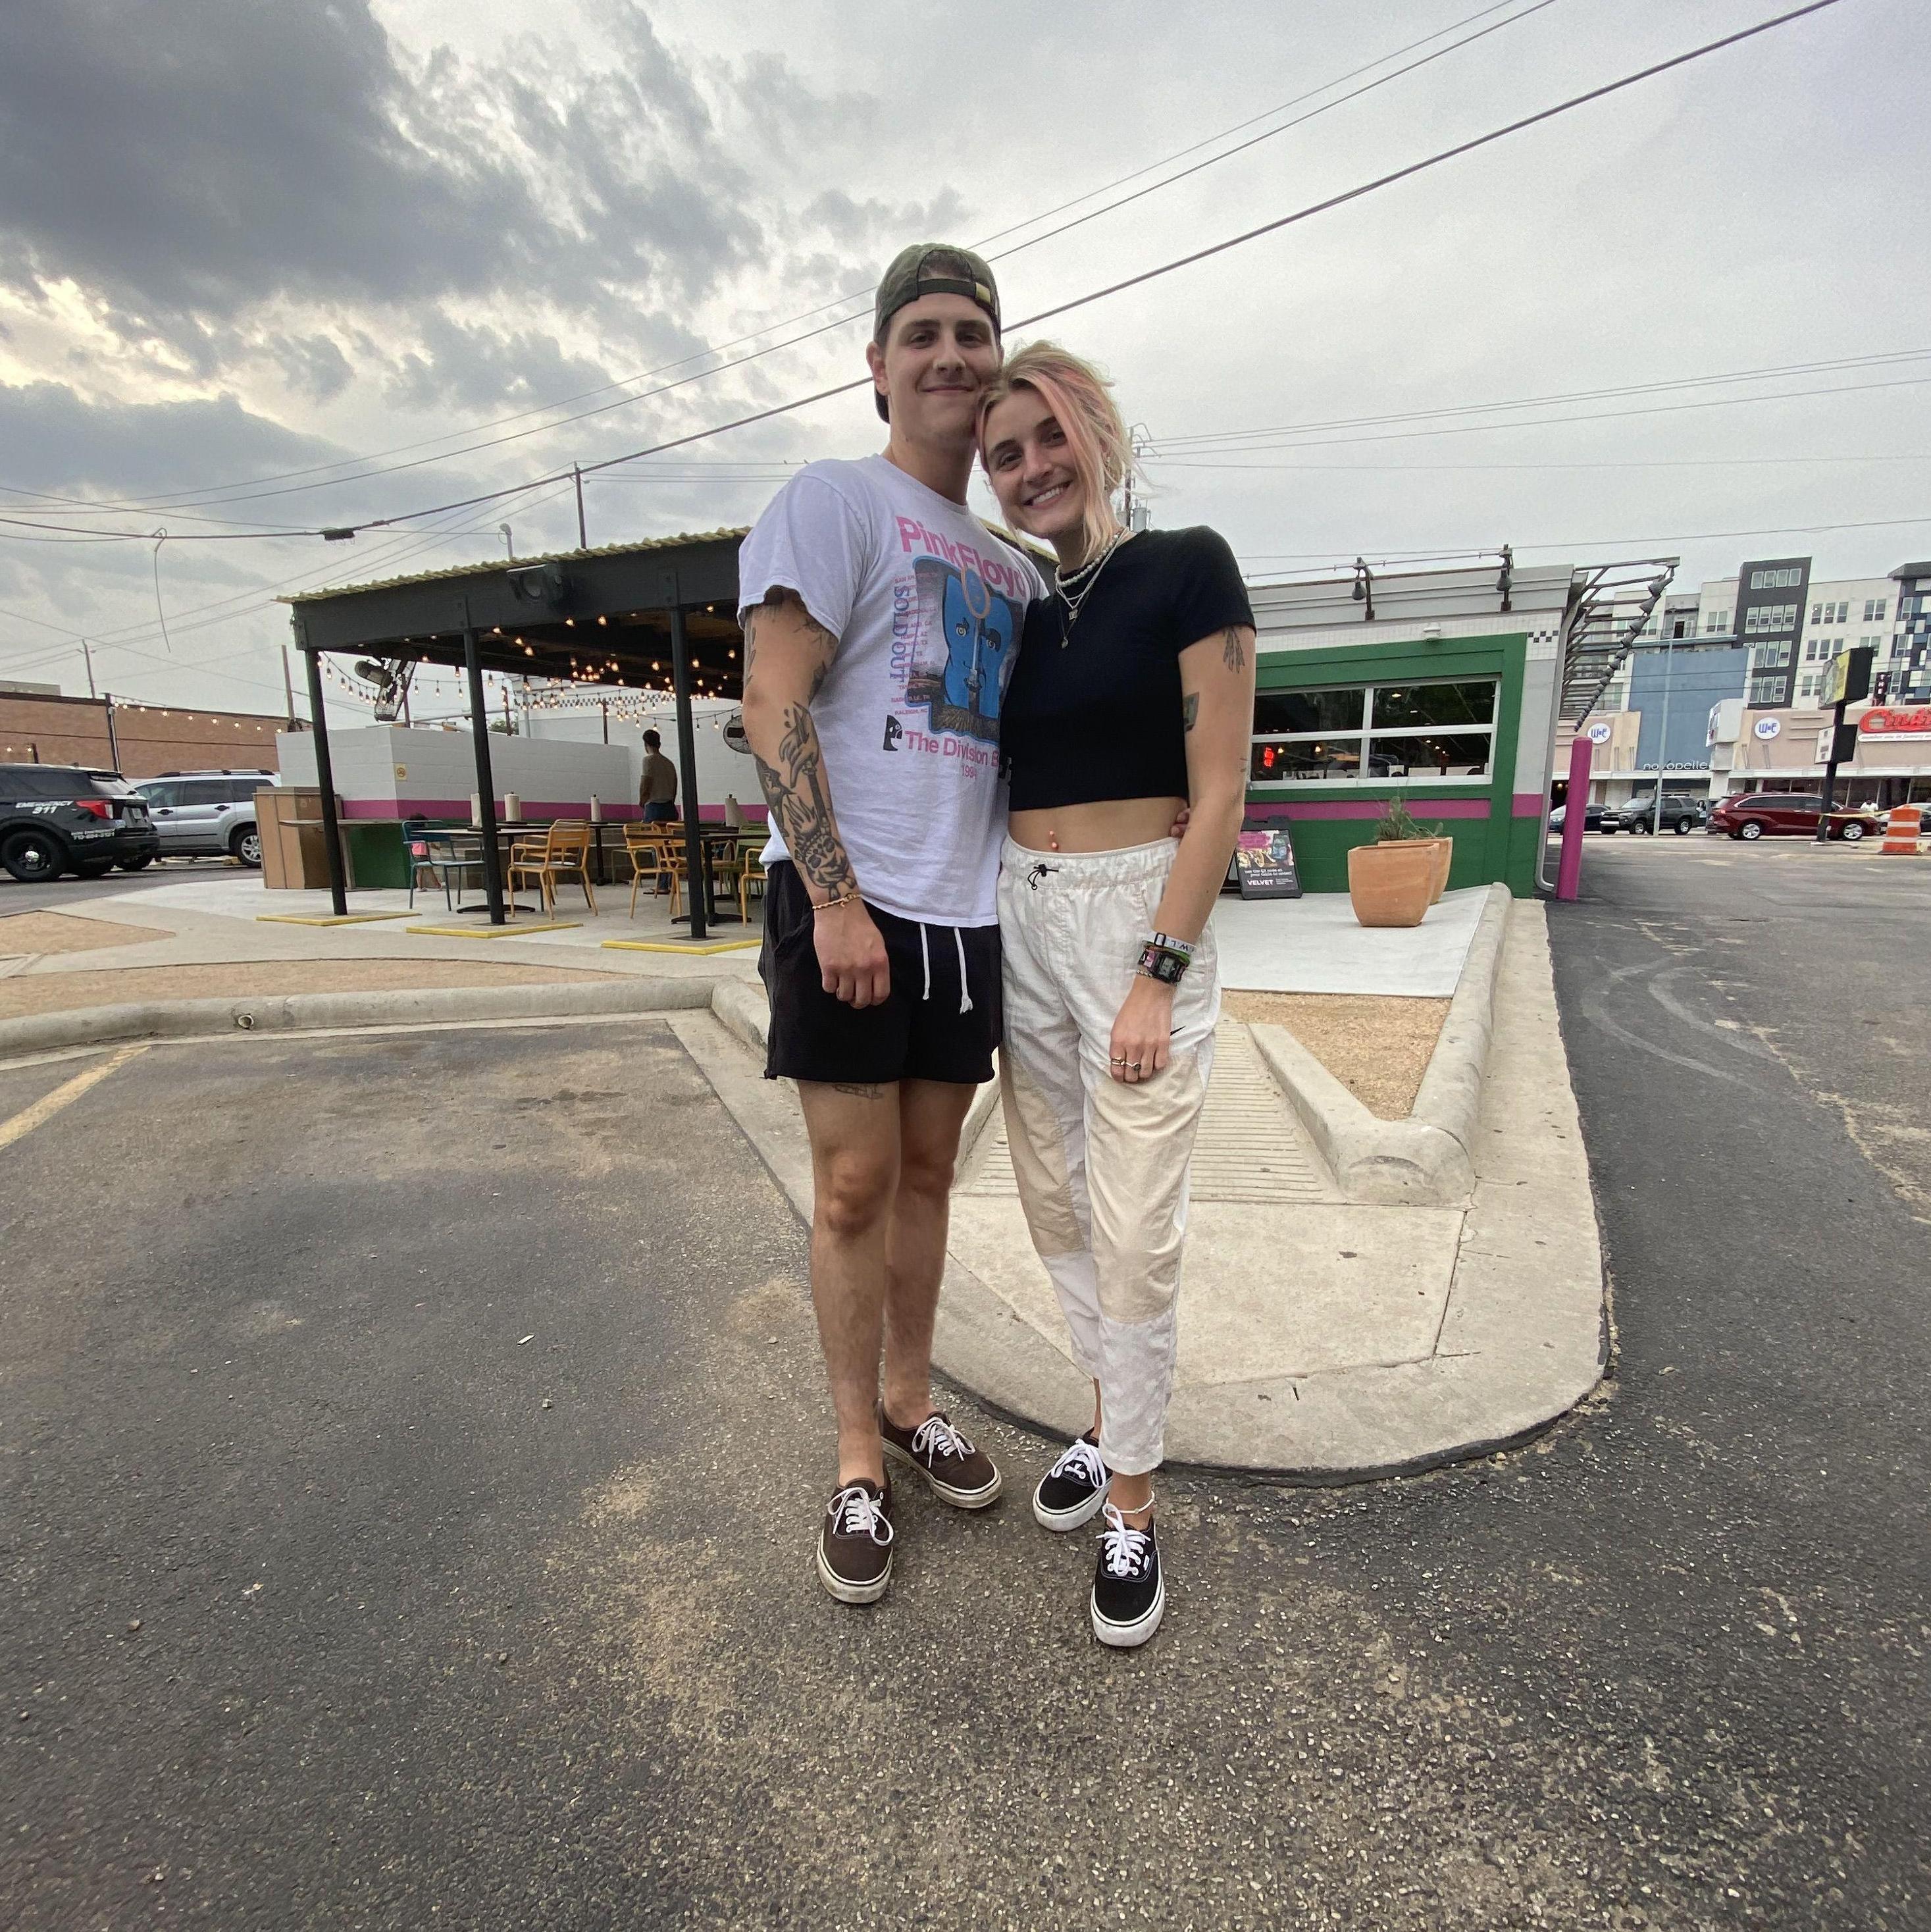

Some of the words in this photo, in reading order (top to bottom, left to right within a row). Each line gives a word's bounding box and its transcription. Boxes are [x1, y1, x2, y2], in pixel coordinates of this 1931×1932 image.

[892, 585, 910, 637] SOLD
[890, 642, 906, 683] OUT
[904, 730, 939, 754] The
[943, 737, 988, 766] Division
[1643, 760, 1709, 771] noopelle
